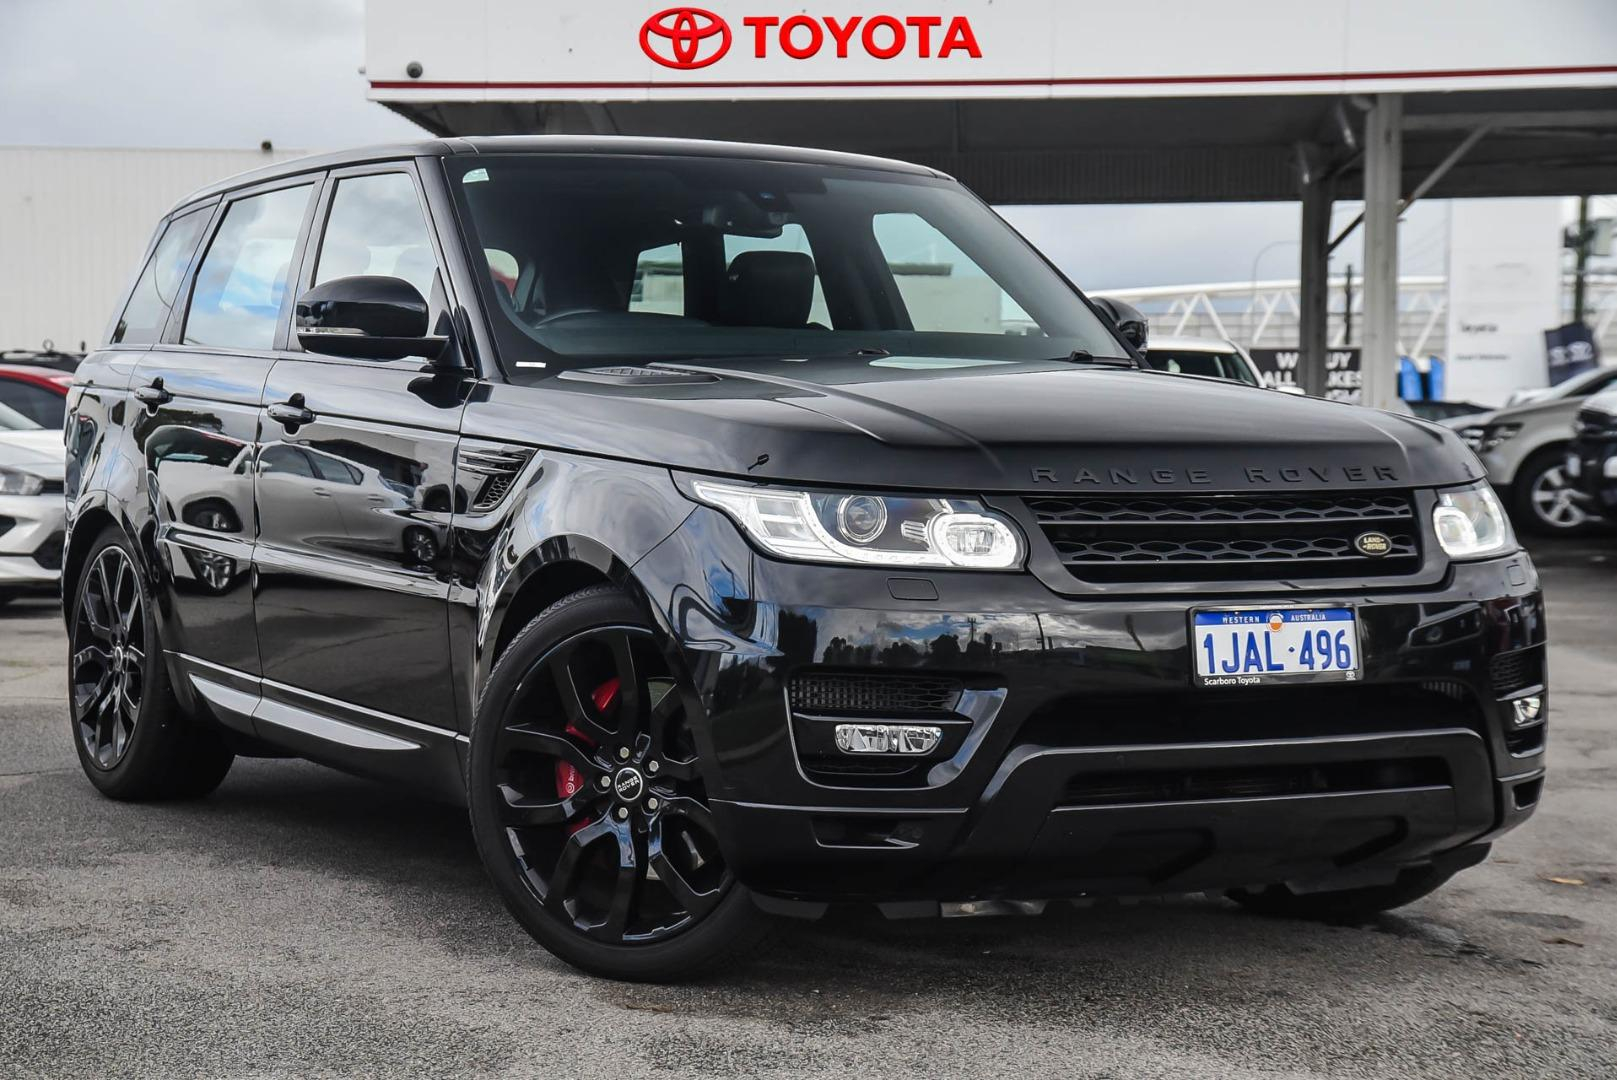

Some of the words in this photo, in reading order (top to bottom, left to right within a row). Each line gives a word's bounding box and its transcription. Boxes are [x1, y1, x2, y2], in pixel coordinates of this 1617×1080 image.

[743, 15, 982, 60] TOYOTA
[1031, 466, 1211, 485] RANGE
[1245, 466, 1399, 483] ROVER
[1222, 615, 1260, 624] WESTERN
[1290, 613, 1327, 622] AUSTRALIA
[1204, 676, 1237, 687] Scarboro
[1237, 676, 1261, 686] Toyota
